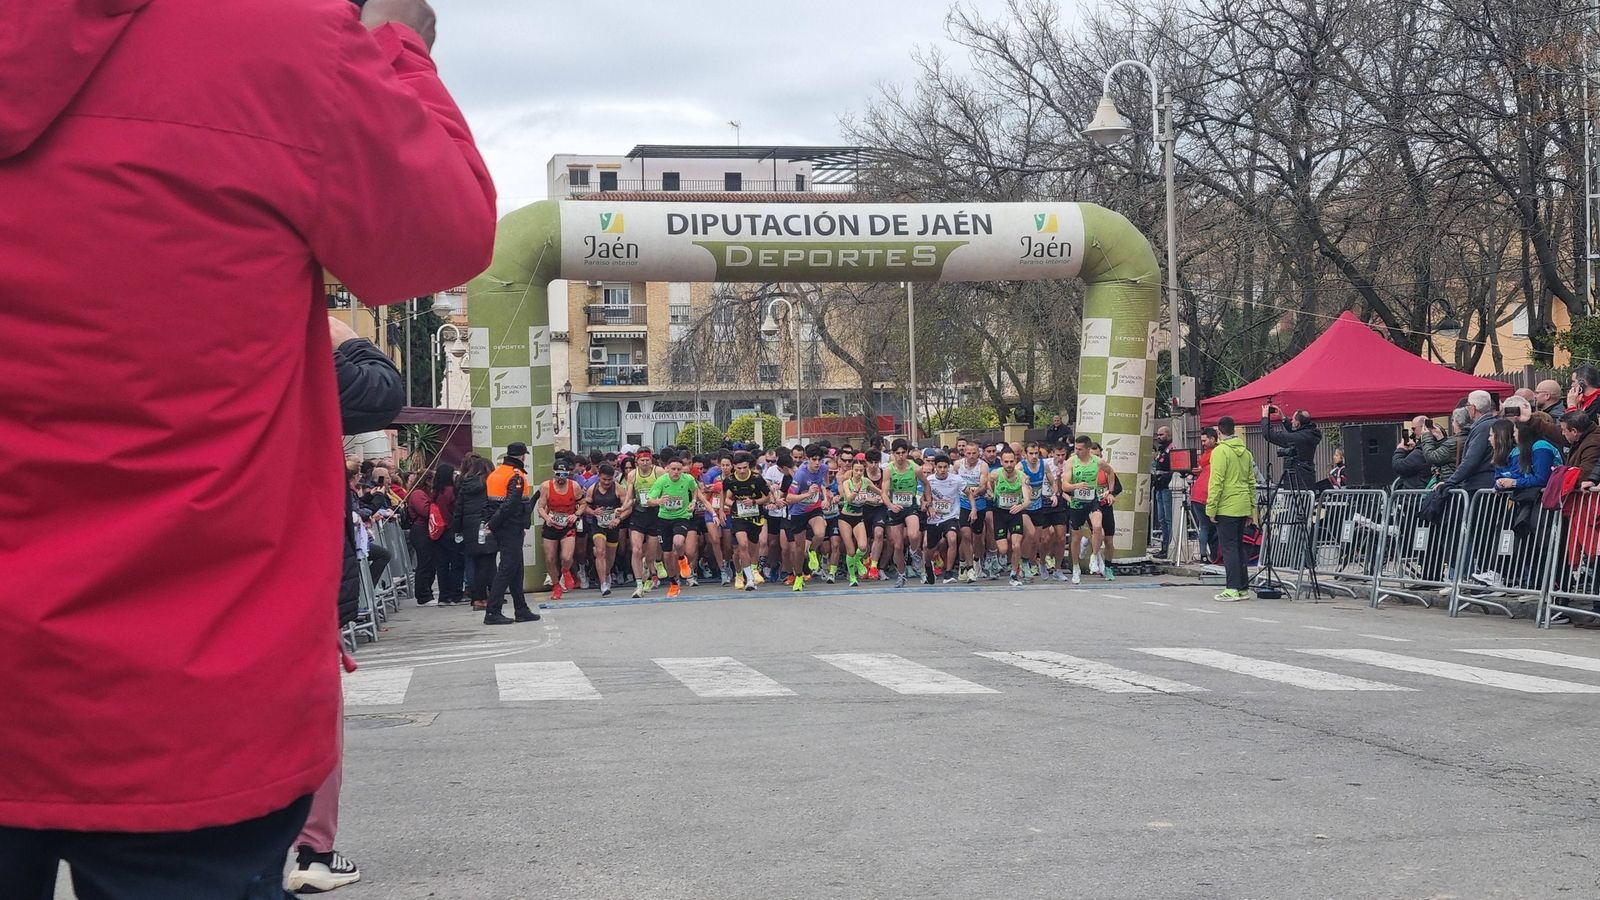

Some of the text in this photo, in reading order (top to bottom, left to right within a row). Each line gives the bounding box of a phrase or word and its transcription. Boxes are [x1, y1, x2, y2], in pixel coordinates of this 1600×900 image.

[666, 210, 993, 236] DIPUTACIÓN DE JAÉN
[584, 235, 639, 259] Jaén
[725, 245, 937, 268] DEPORTES
[1020, 236, 1072, 259] Jaén
